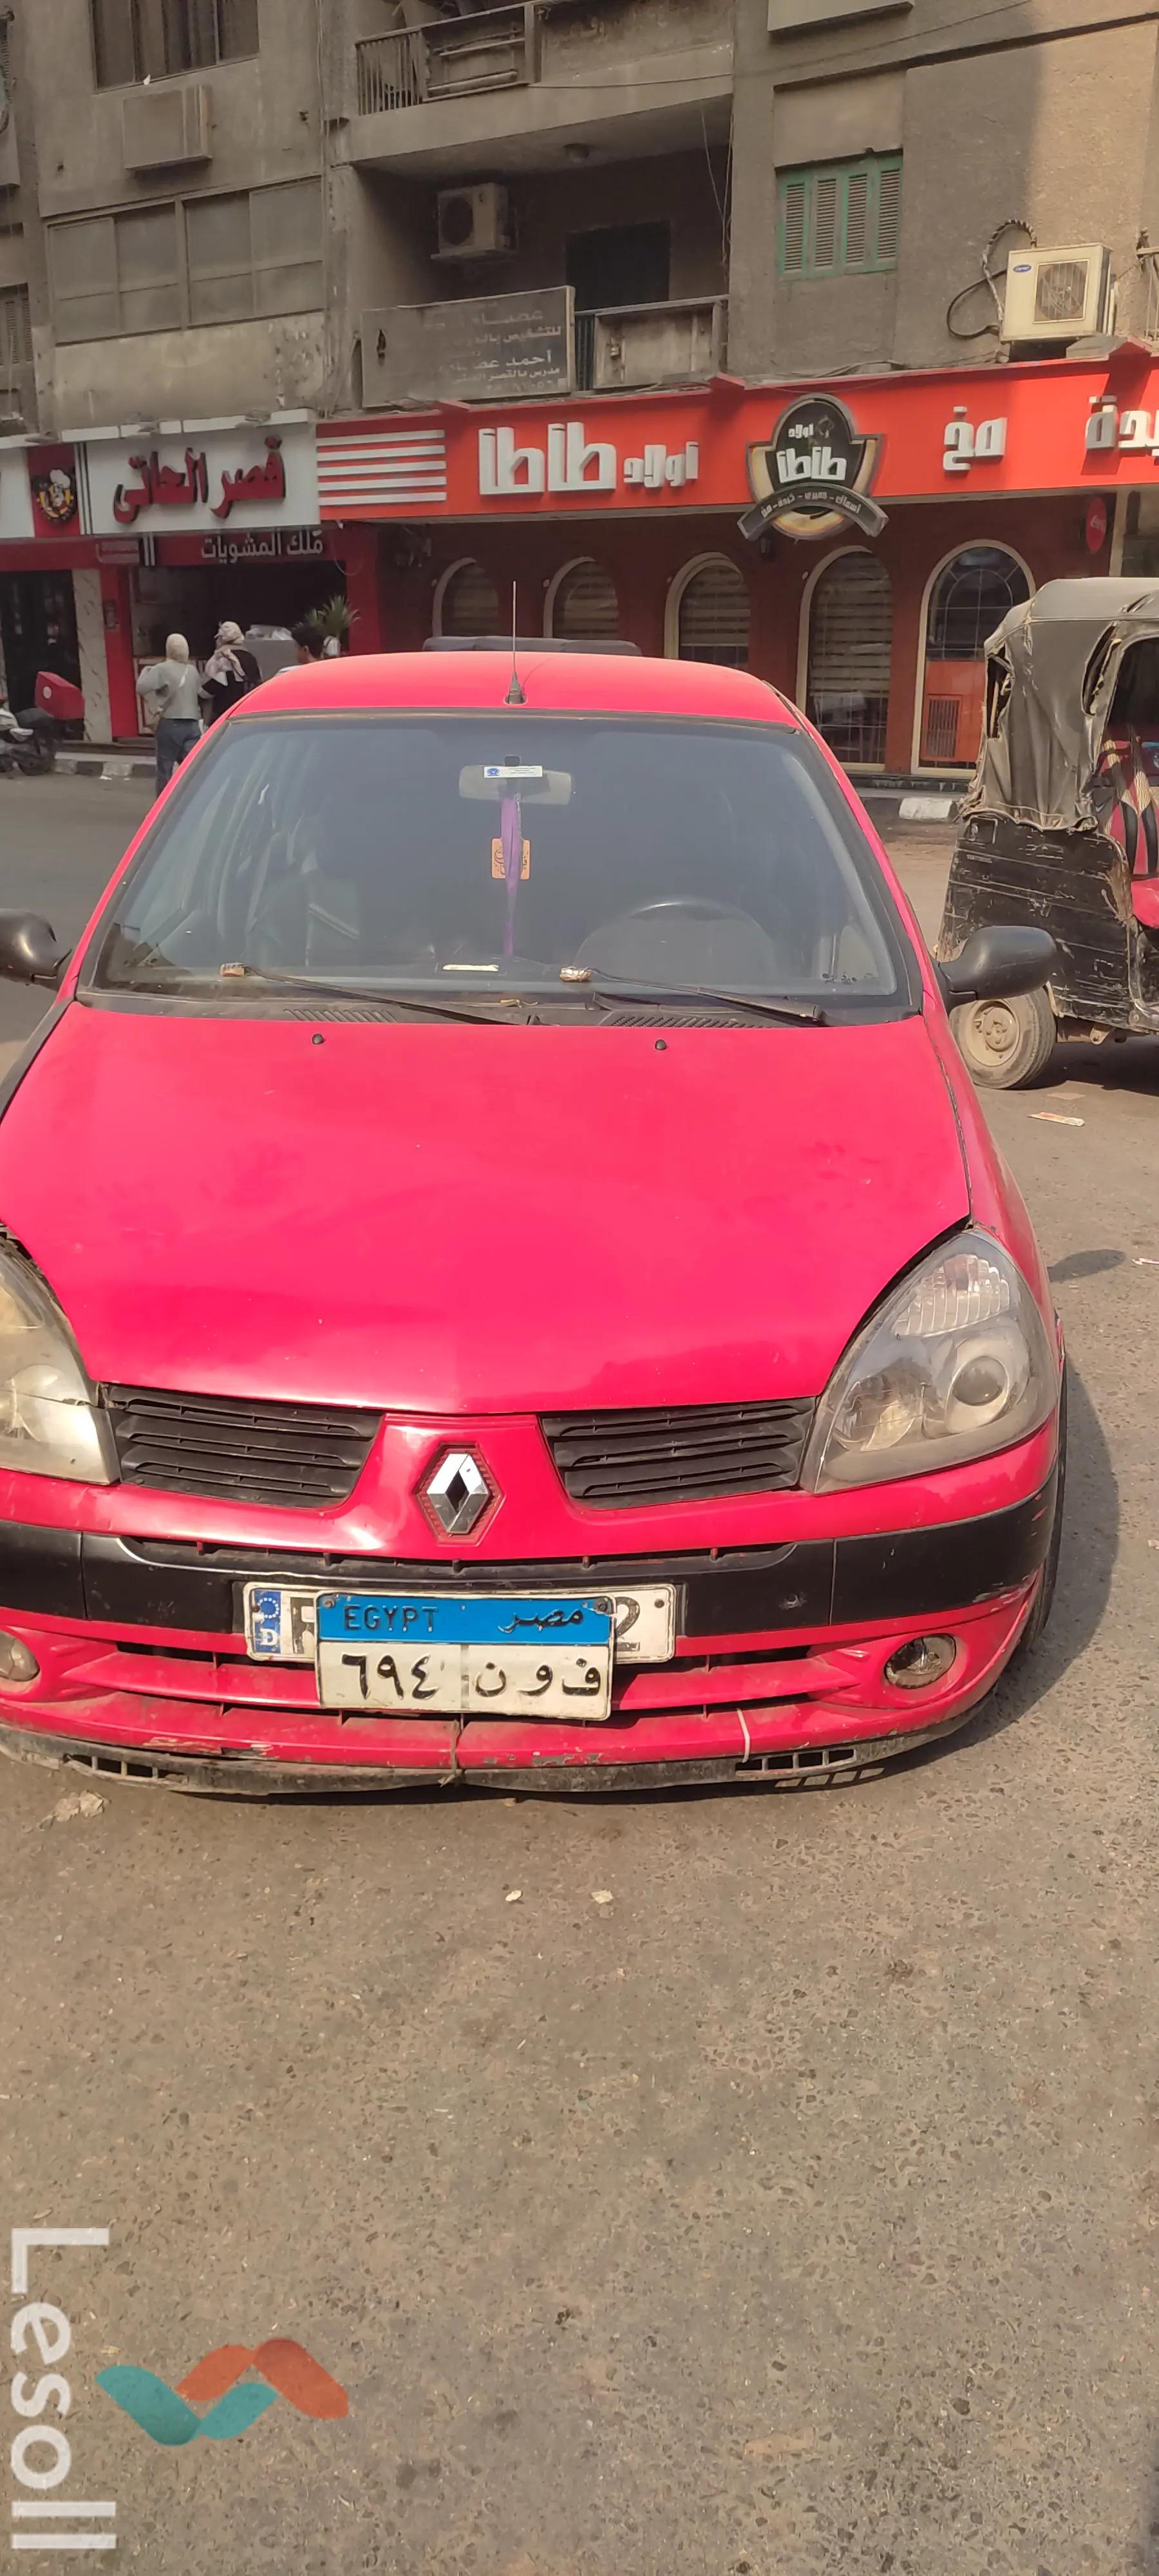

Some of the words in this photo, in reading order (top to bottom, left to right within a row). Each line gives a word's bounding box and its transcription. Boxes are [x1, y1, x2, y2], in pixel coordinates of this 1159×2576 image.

[943, 406, 1008, 470] مخ
[210, 435, 286, 518] قصر
[201, 531, 281, 564] المشويات
[344, 1604, 438, 1634] EGYPT
[498, 1607, 585, 1634] مصر
[341, 1653, 440, 1701] ٦٩٤
